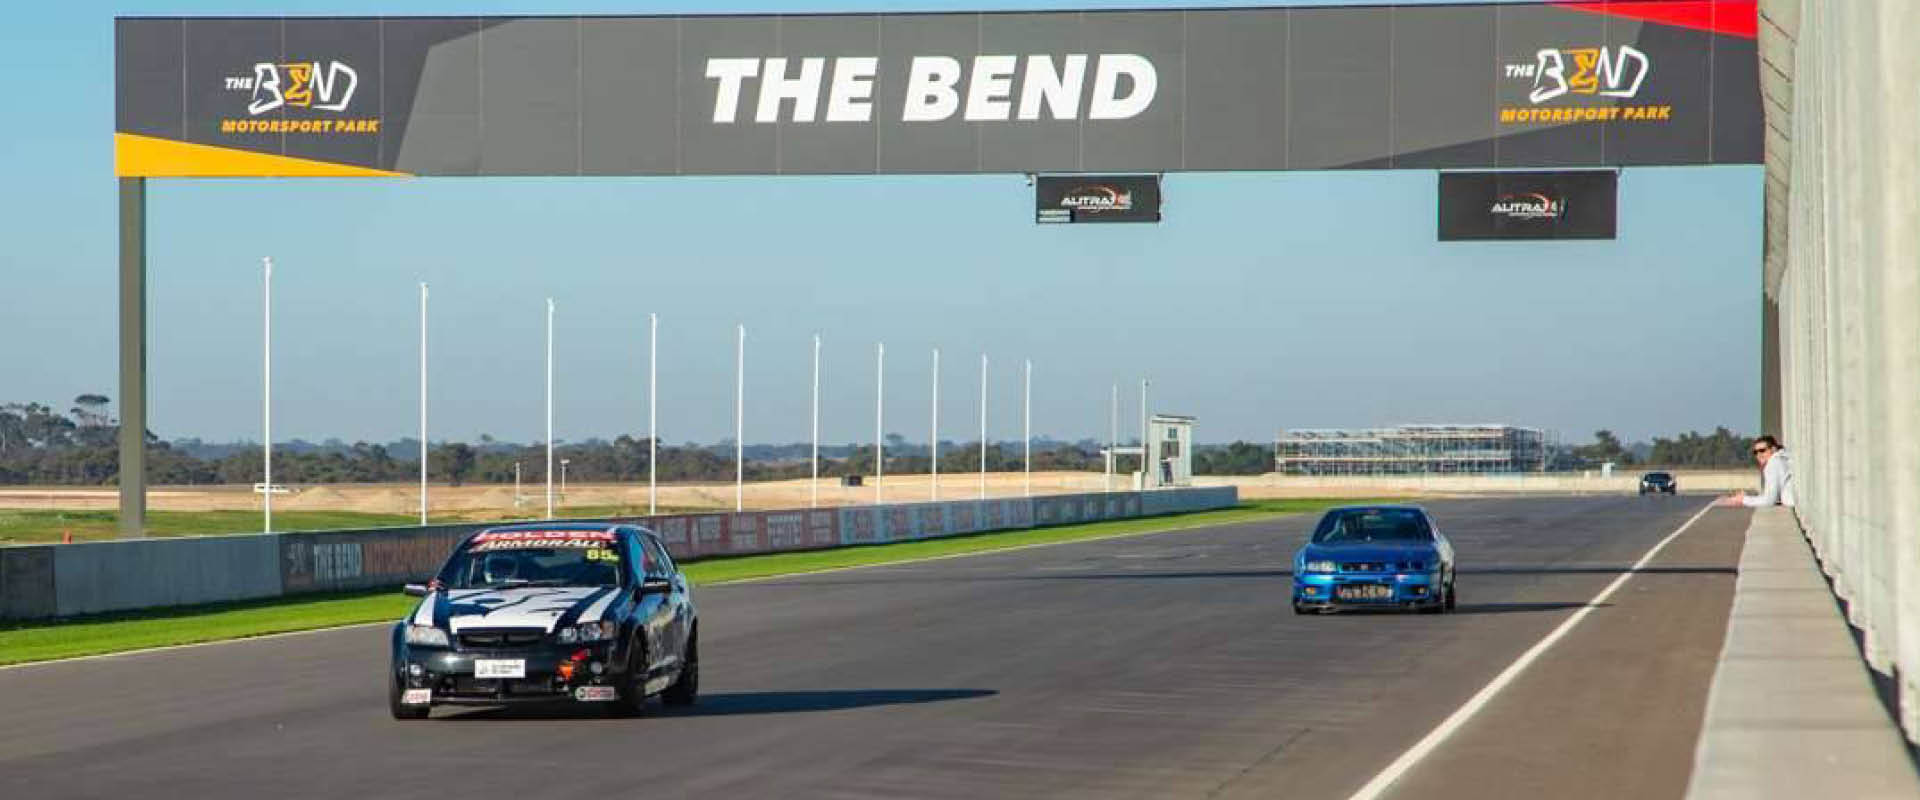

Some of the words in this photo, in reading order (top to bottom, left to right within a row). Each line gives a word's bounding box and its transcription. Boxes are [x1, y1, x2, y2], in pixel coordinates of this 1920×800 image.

[1504, 63, 1536, 78] THE
[224, 77, 254, 90] THE
[704, 57, 879, 124] THE
[901, 53, 1158, 122] BEND
[1500, 107, 1622, 124] MOTORSPORT
[1623, 105, 1672, 121] PARK
[222, 119, 333, 133] MOTORSPORT
[334, 119, 380, 133] PARK
[483, 531, 614, 541] HOLDEN
